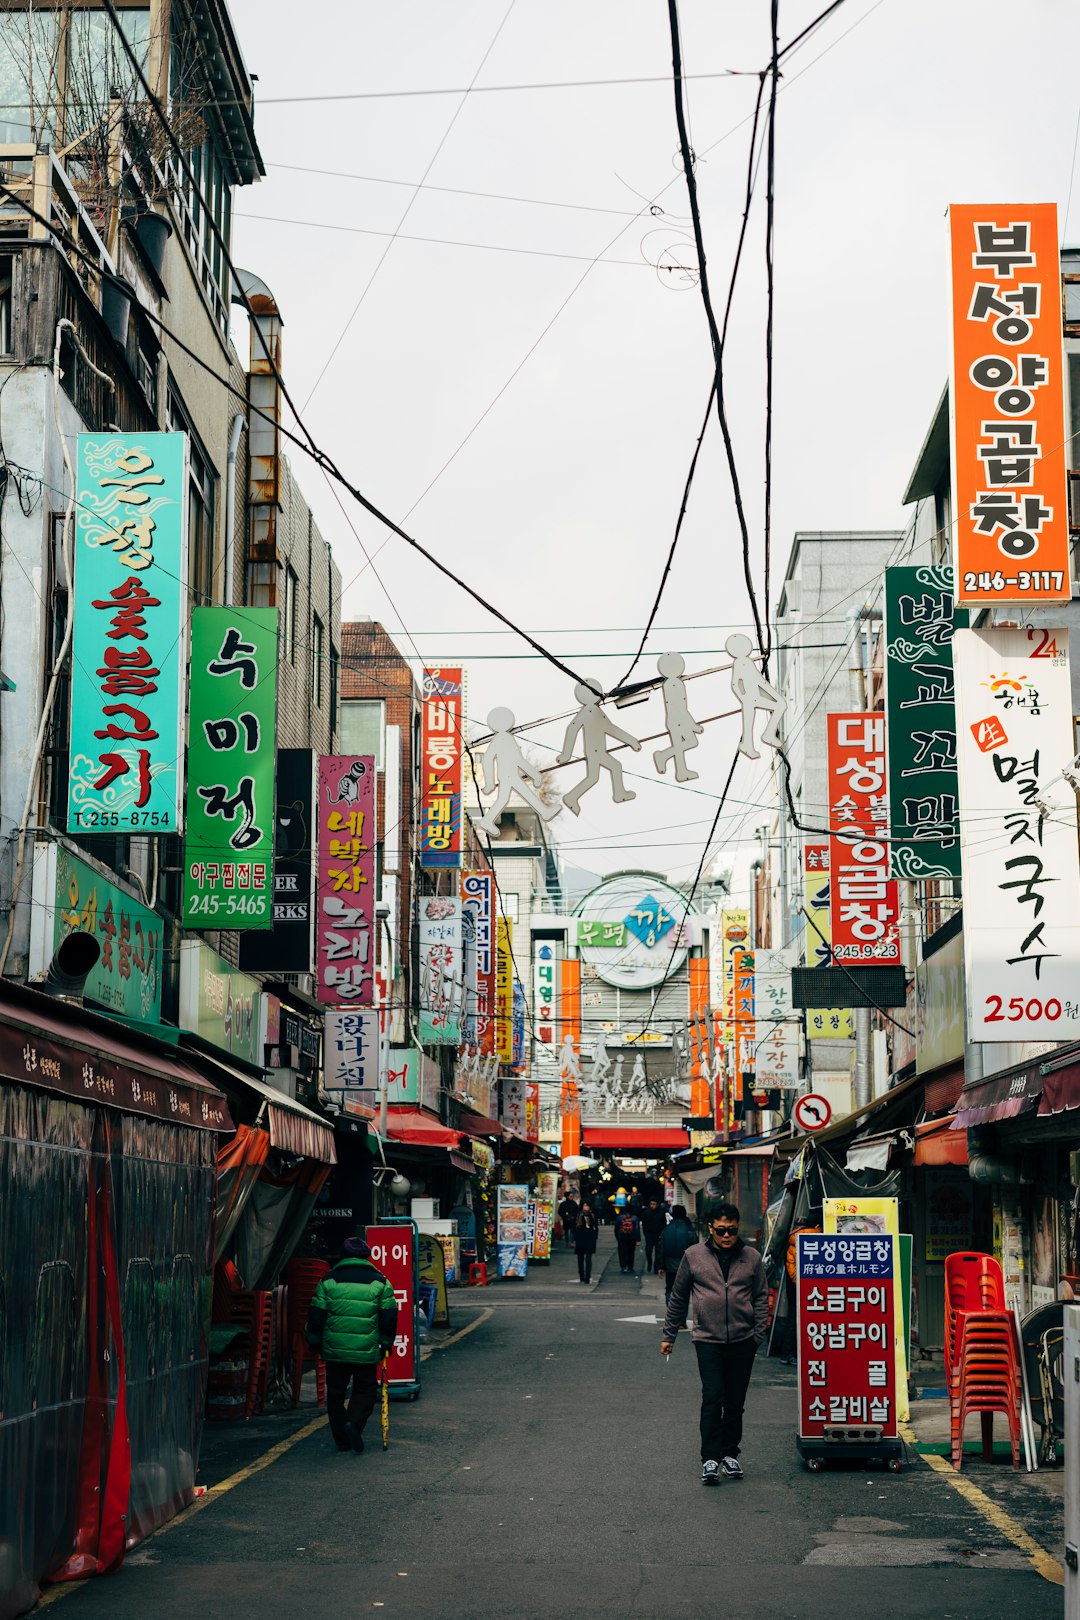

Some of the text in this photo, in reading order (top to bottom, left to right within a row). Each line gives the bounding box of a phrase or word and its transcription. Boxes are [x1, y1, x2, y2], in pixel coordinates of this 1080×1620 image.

[966, 222, 1054, 559] 부성양곱창
[963, 570, 1065, 592] 246-3117
[1028, 628, 1066, 658] 24시
[197, 626, 262, 850] 수미정
[74, 811, 170, 828] T.255-8754
[190, 862, 266, 889] 아구찜전문
[992, 748, 1062, 981] 멸치국수
[188, 894, 266, 914] 245-5465
[427, 924, 455, 939] 자갈치
[834, 944, 897, 959] 245.923
[319, 1208, 353, 1217] WORKS
[803, 1240, 891, 1262] 부성양곱창
[803, 1263, 890, 1274] 府省の量ホルモン
[806, 1286, 887, 1313] 소금구이
[806, 1322, 887, 1350] 양념구이
[808, 1396, 890, 1422] 소갈비살
